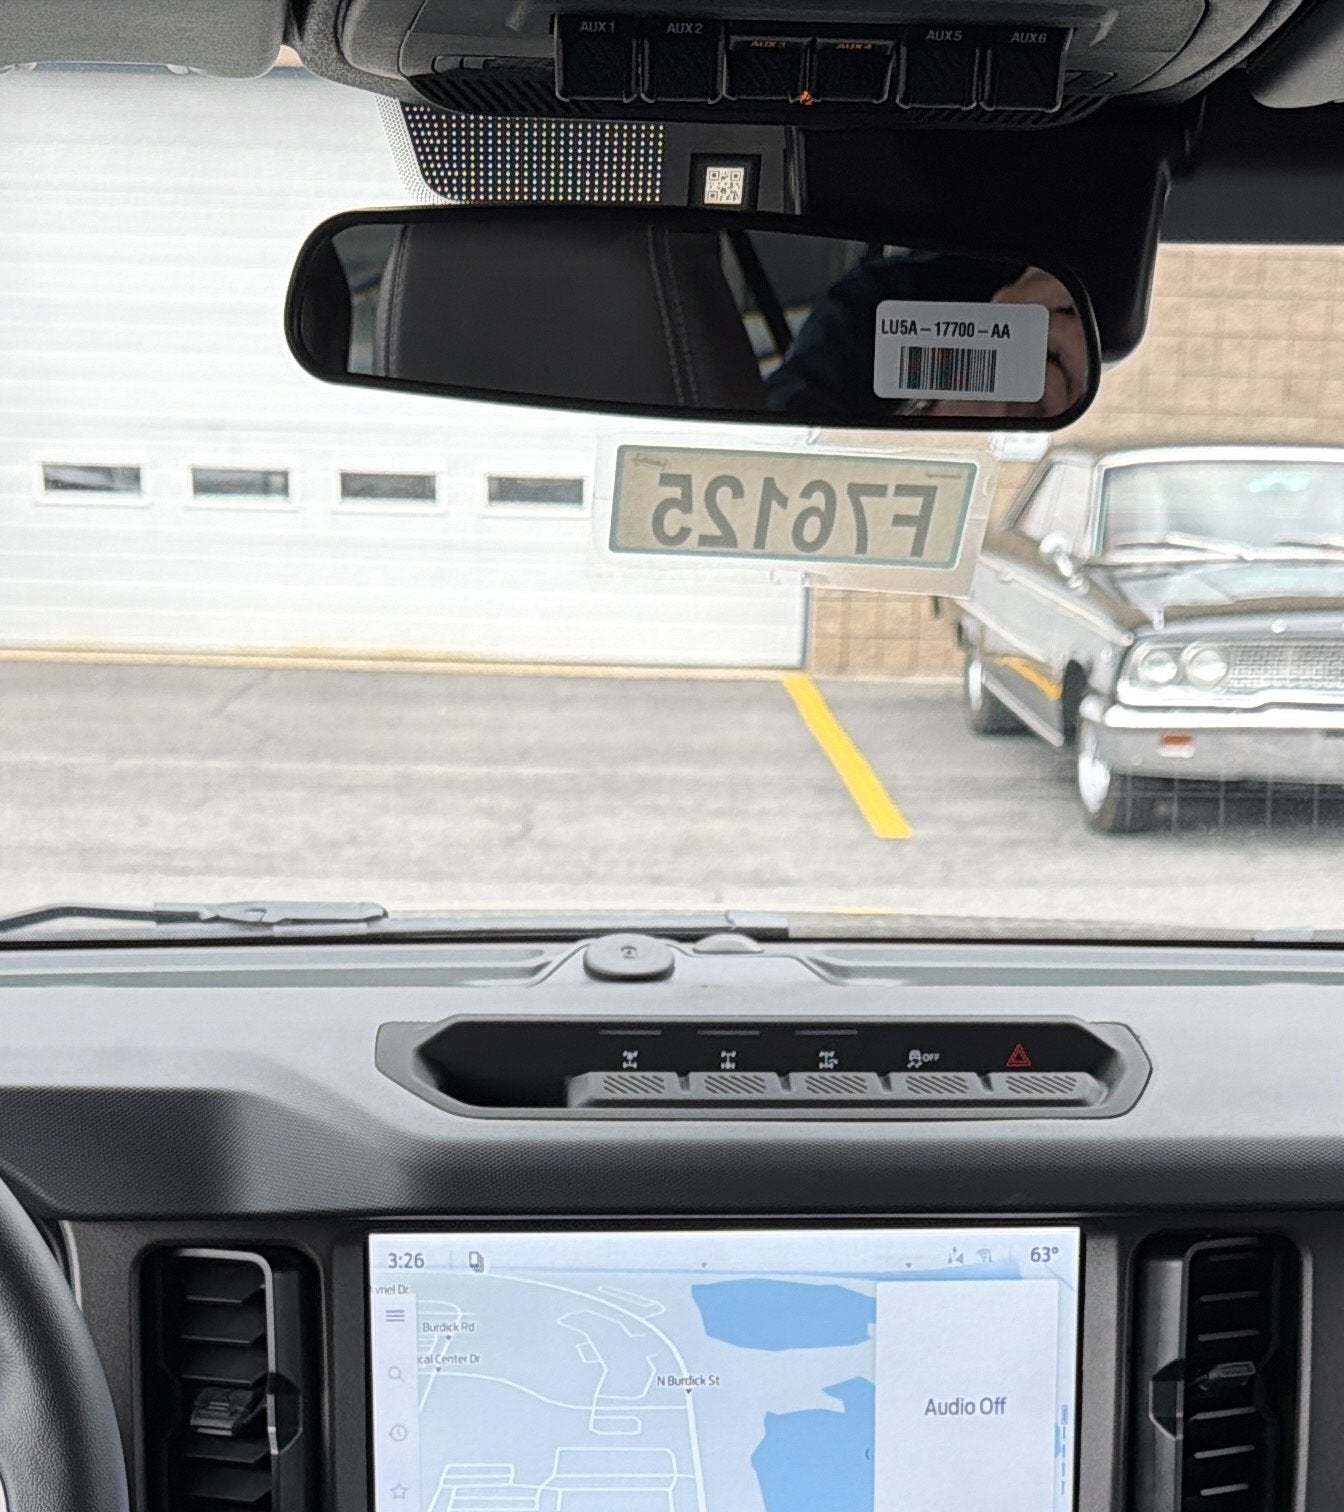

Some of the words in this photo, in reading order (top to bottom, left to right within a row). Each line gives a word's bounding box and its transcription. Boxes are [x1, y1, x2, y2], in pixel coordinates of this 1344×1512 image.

[922, 1053, 940, 1063] OFF
[387, 1252, 425, 1269] 3:26
[1030, 1246, 1059, 1263] 63°
[422, 1321, 459, 1333] Burdick
[461, 1321, 475, 1333] Rd
[435, 1353, 468, 1365] Center
[470, 1353, 481, 1364] Dr
[657, 1376, 666, 1386] N
[667, 1375, 706, 1387] Burdick
[708, 1375, 720, 1386] St
[924, 1397, 976, 1416] Audio
[979, 1397, 1007, 1415] Off
